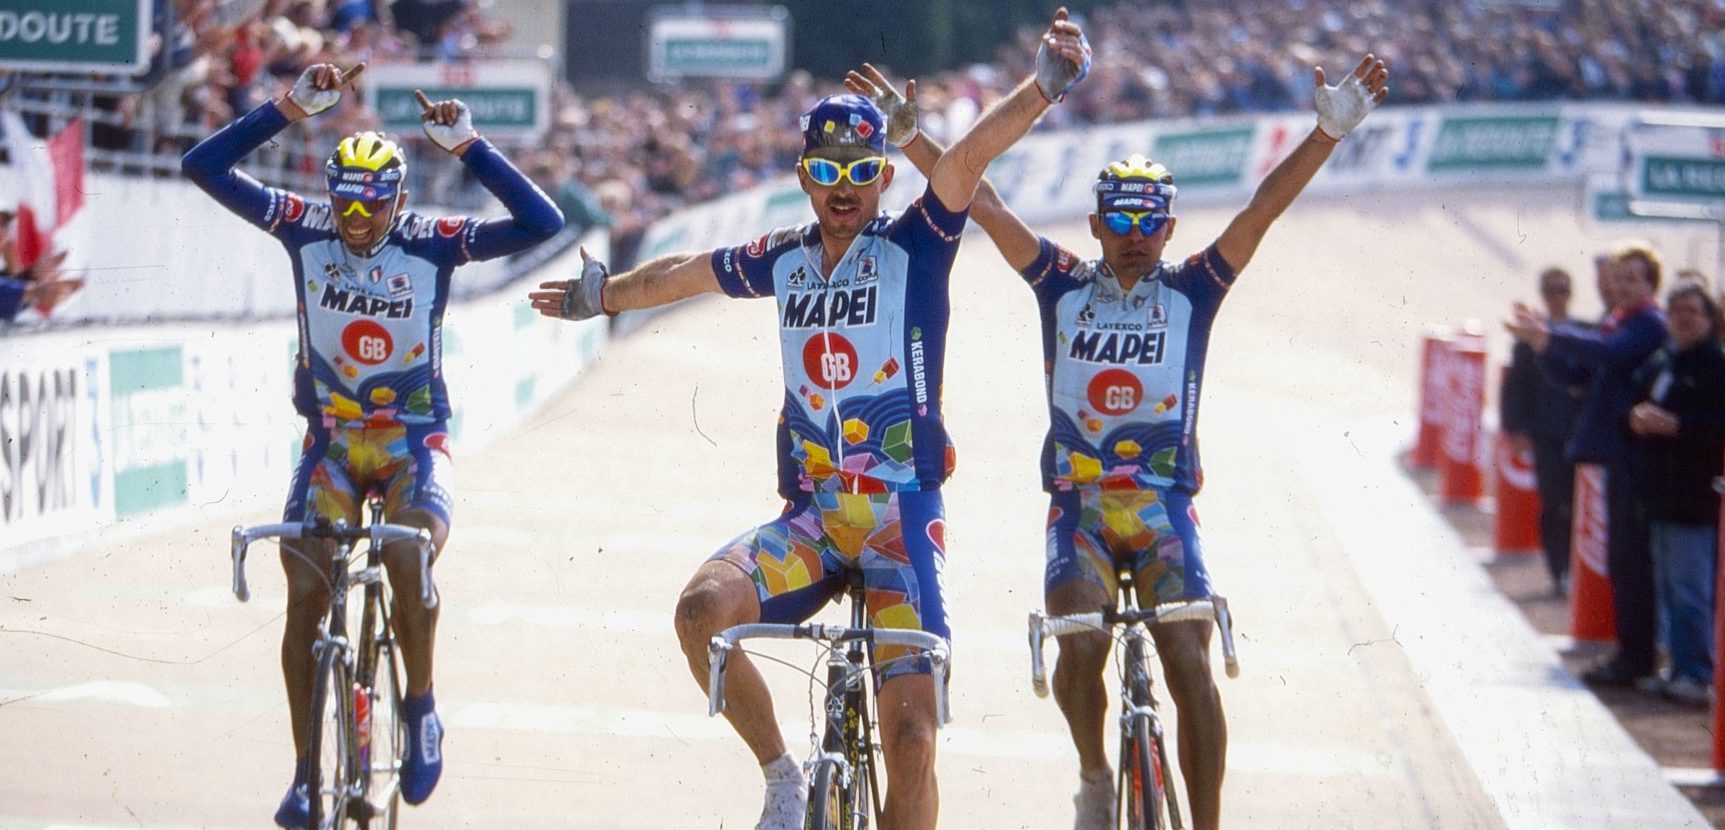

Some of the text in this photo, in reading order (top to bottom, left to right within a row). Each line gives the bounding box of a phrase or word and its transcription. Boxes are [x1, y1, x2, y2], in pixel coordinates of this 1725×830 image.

[320, 283, 413, 319] MAPEI
[782, 285, 878, 328] MAPEI
[1096, 322, 1143, 331] LATEXCO
[358, 335, 387, 361] GB
[1069, 330, 1166, 365] MAPEI
[820, 351, 851, 382] GB
[910, 340, 928, 404] KERABOND
[1104, 385, 1135, 410] GB
[0, 368, 75, 522] SPORT
